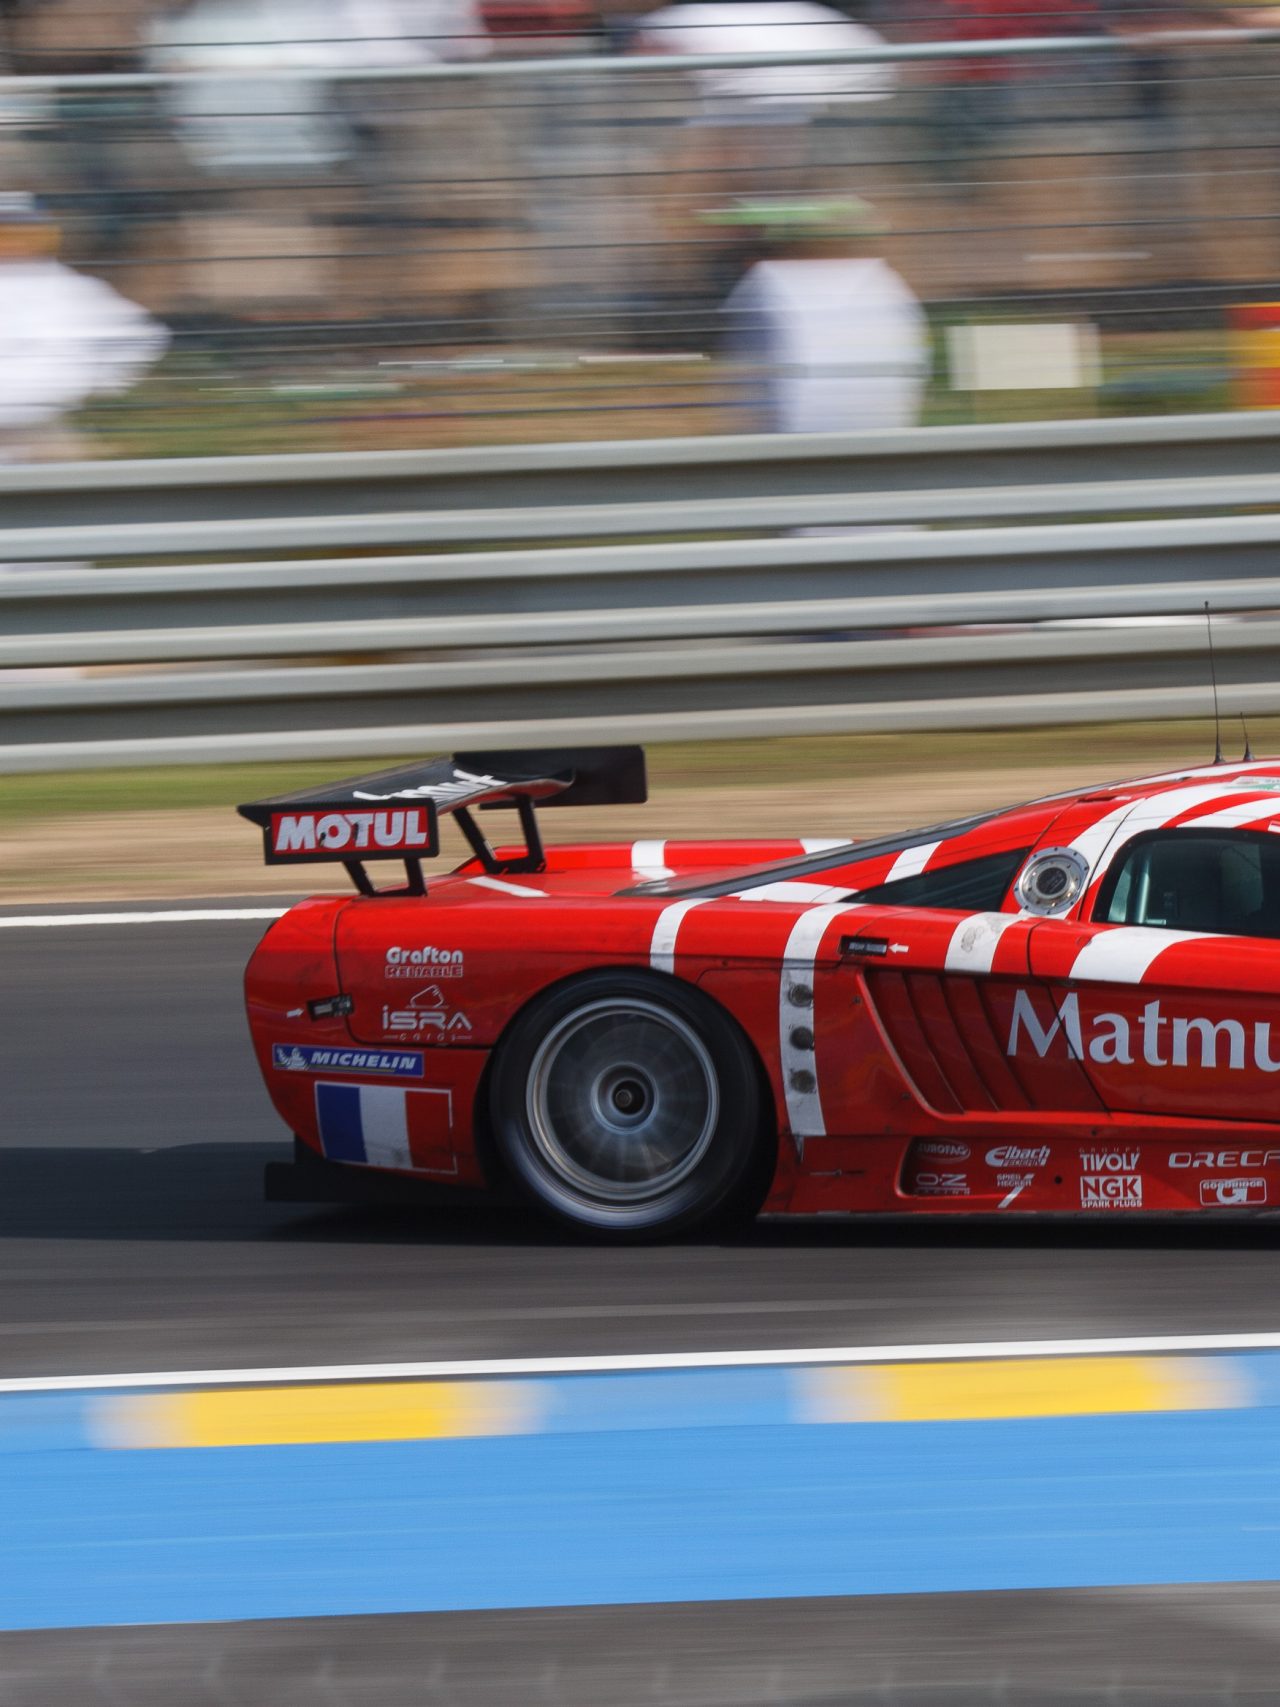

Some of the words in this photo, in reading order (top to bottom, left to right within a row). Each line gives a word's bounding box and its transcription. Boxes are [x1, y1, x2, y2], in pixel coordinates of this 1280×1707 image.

[275, 811, 428, 851] MOTUL
[386, 946, 464, 964] Grafton
[311, 1051, 417, 1070] MICHELIN
[1079, 1153, 1141, 1172] TIVOLY
[1082, 1177, 1141, 1199] NGK
[1081, 1200, 1110, 1209] SPARK
[1113, 1200, 1142, 1208] PLUGS
